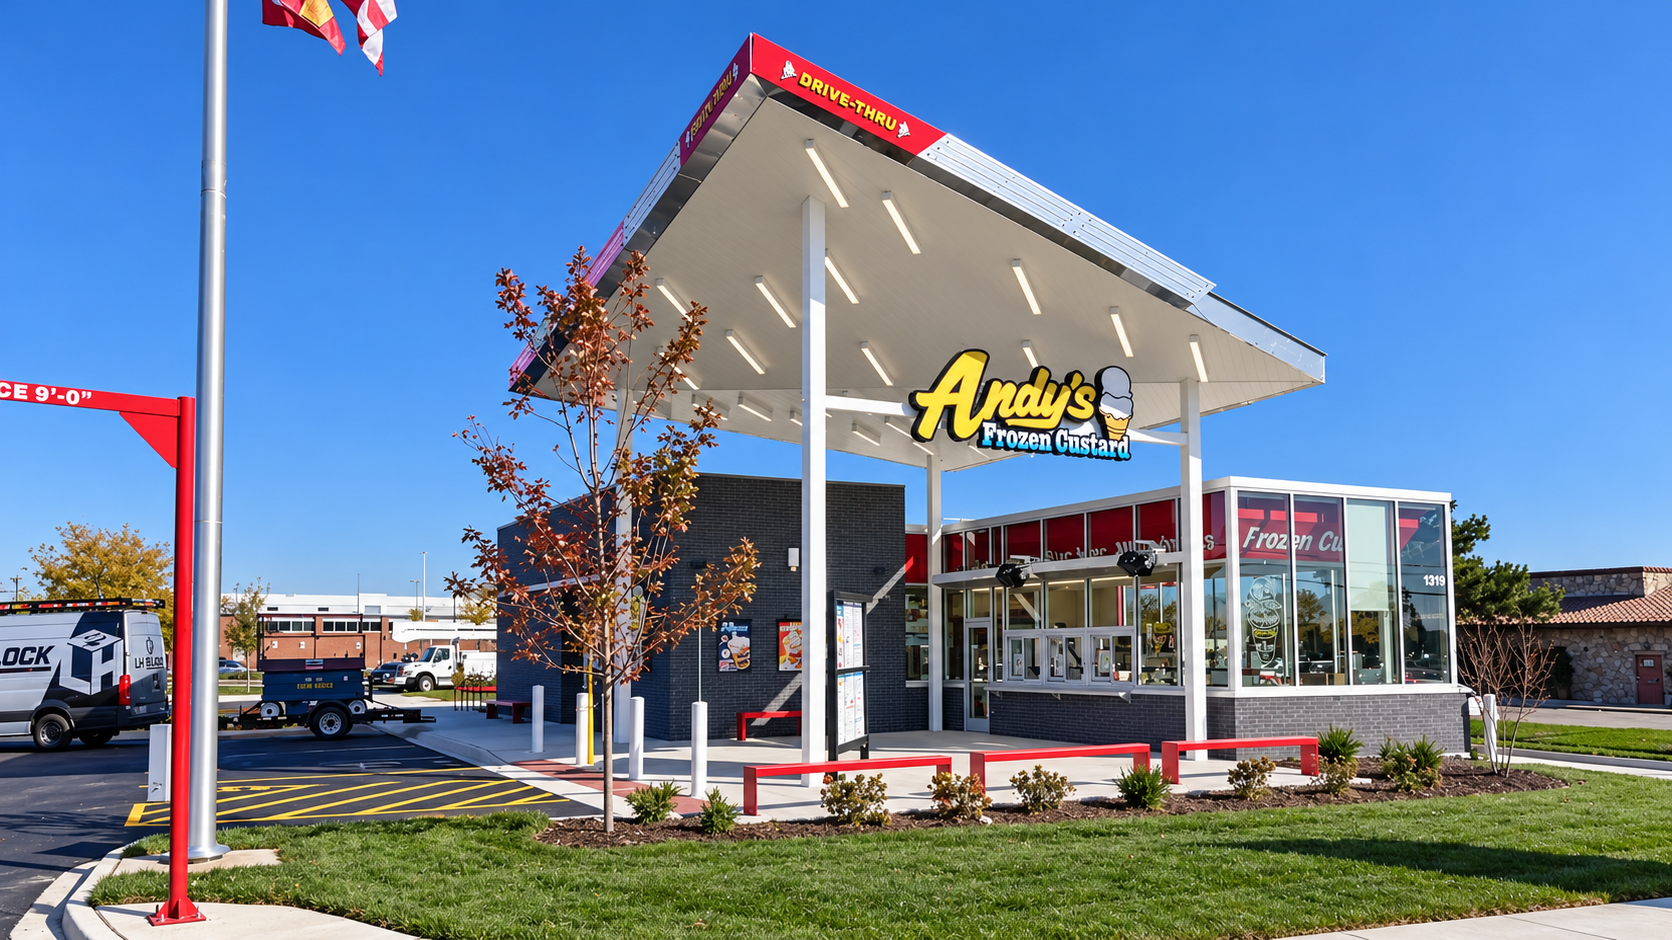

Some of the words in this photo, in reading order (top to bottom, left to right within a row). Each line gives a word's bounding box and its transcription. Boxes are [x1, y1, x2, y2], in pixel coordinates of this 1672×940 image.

[798, 71, 898, 131] DRIVE-THRU
[0, 382, 28, 399] CE
[913, 350, 1097, 440] Andy's
[982, 421, 1053, 452] Frozen
[1055, 430, 1131, 460] Custard
[1242, 526, 1314, 551] Frozen
[1423, 574, 1446, 586] 1319
[0, 645, 55, 666] OCK
